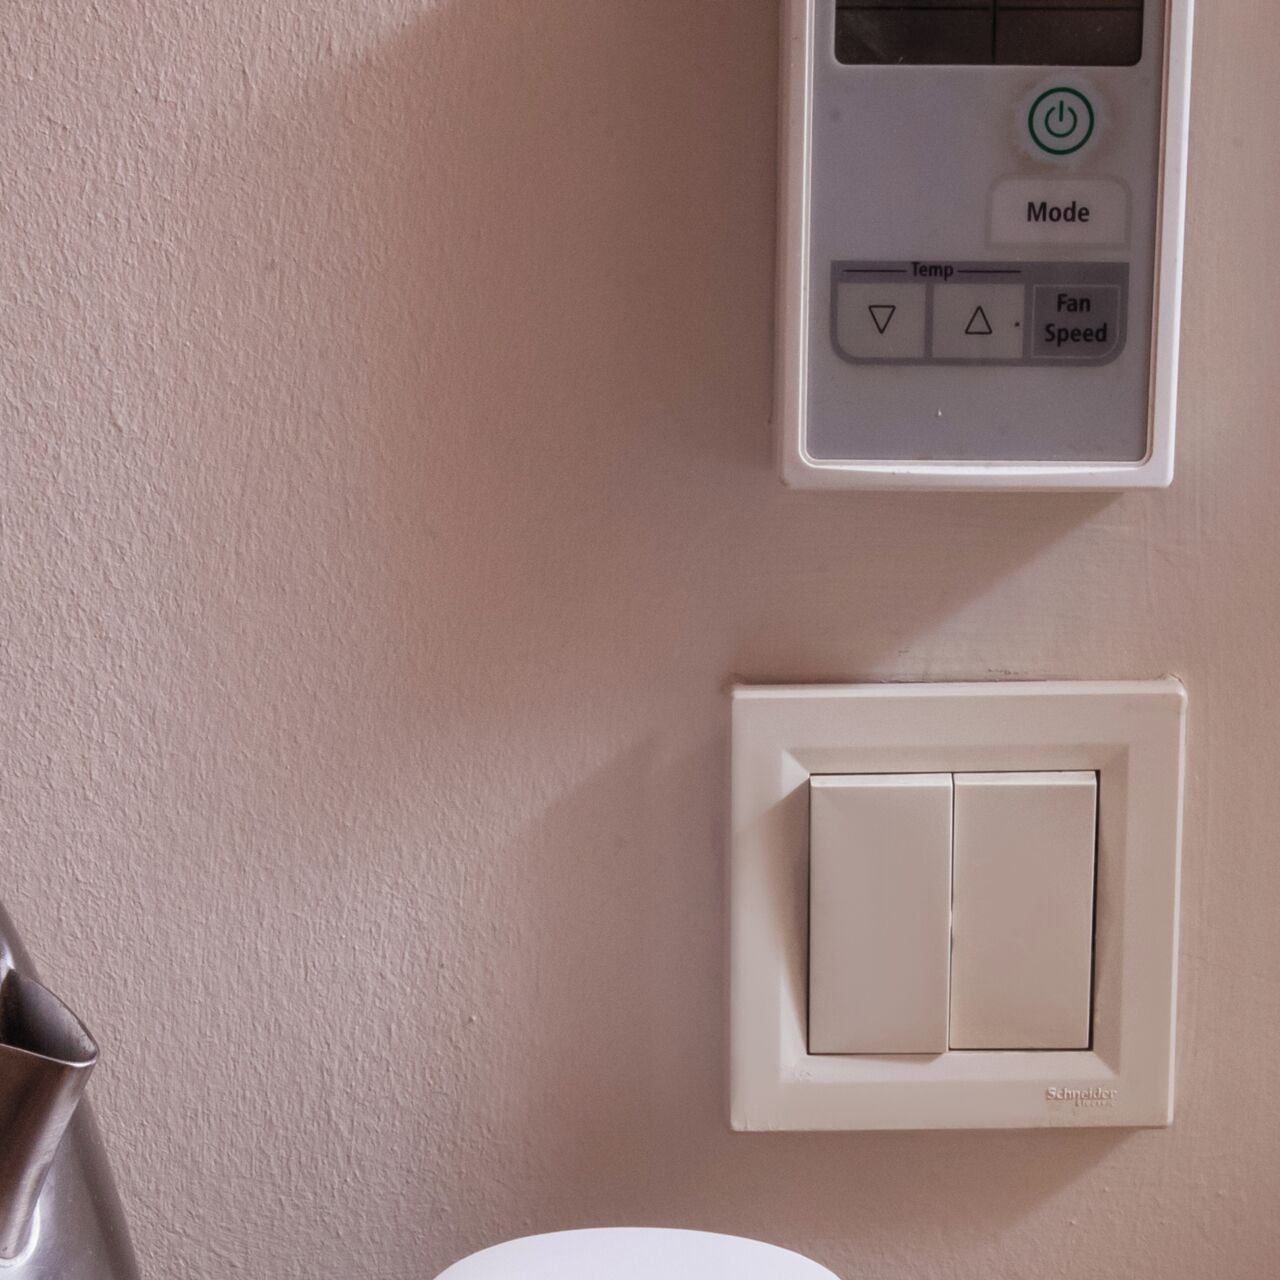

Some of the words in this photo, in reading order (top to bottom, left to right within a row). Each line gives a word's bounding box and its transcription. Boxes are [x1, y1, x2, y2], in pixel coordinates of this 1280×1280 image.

[1026, 200, 1090, 224] Mode
[911, 262, 954, 280] Temp
[1056, 294, 1091, 312] Fan
[1044, 323, 1107, 346] Speed
[1047, 1086, 1117, 1101] Schneider
